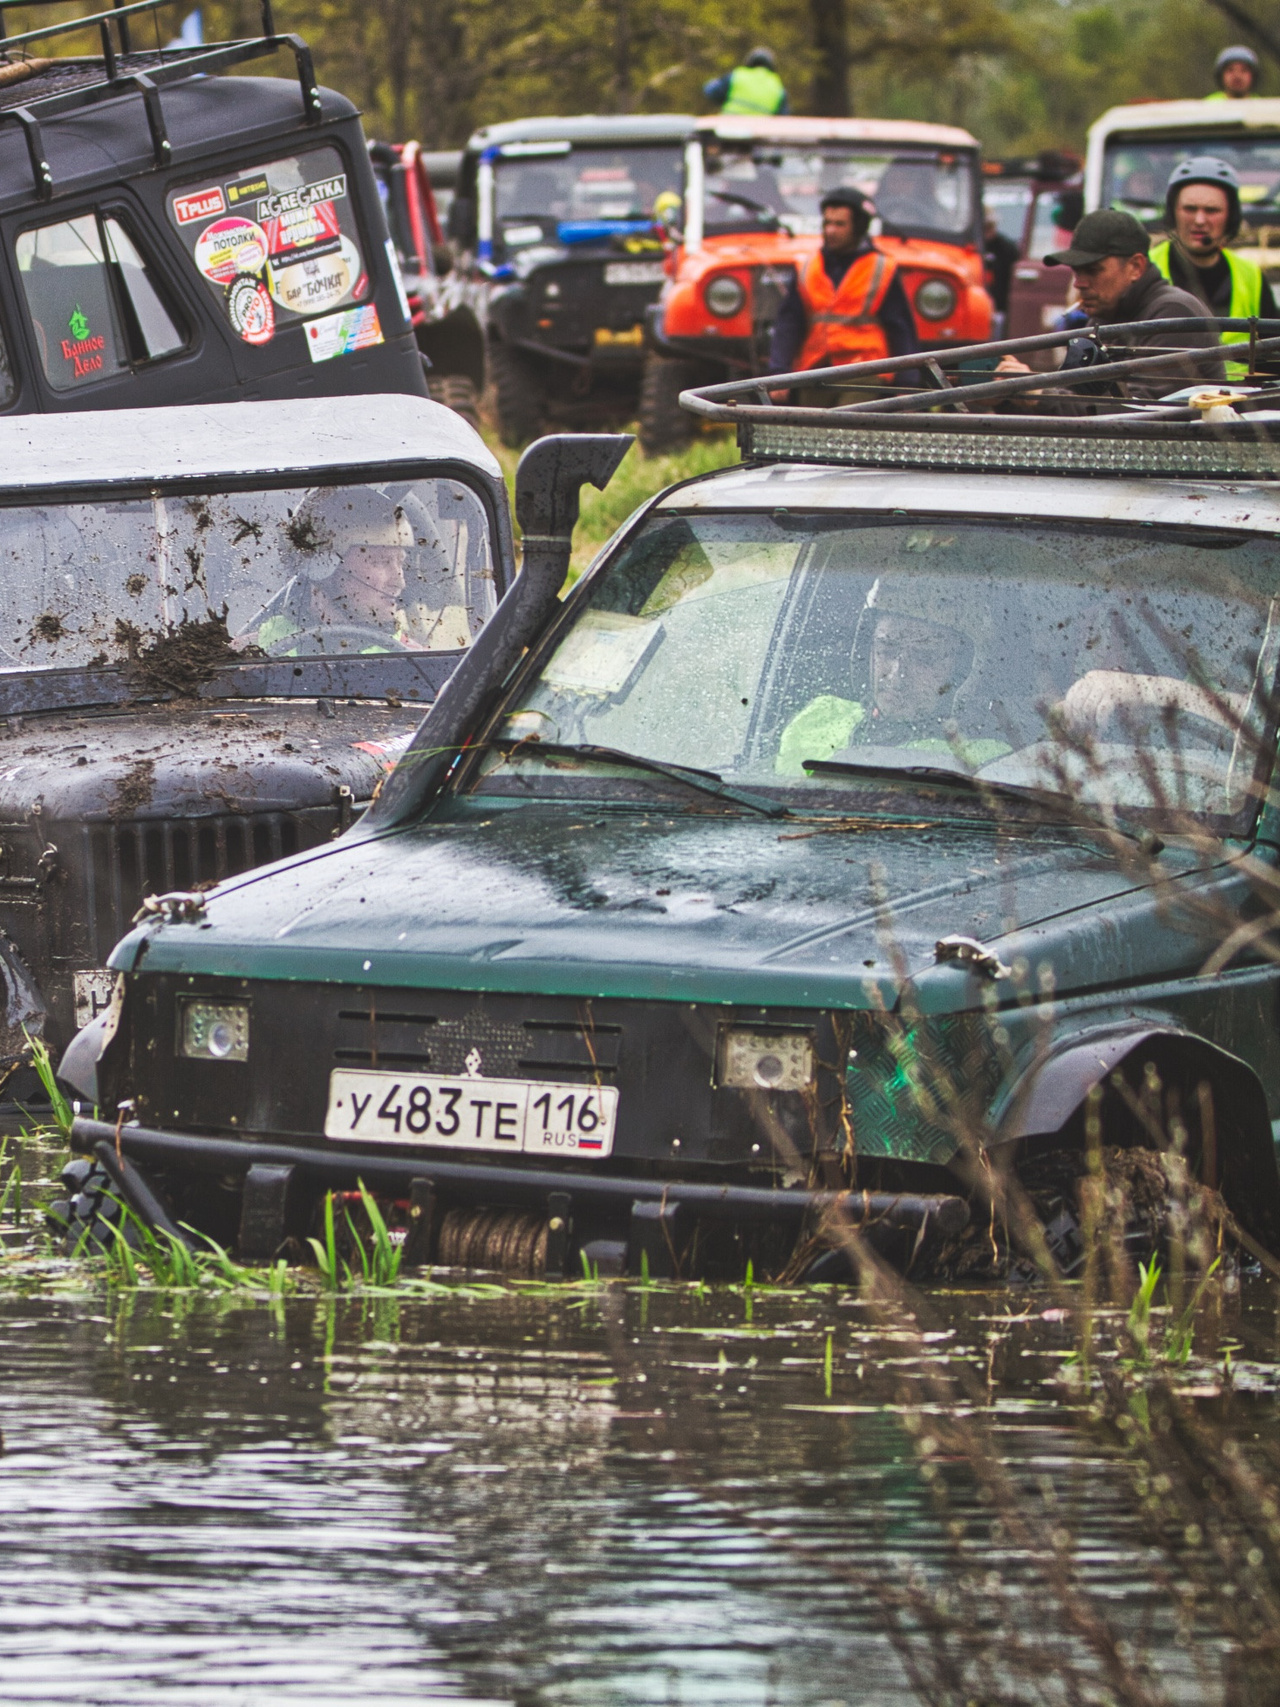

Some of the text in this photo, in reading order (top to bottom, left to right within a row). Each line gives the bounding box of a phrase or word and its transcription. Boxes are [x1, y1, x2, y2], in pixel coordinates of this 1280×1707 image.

[177, 196, 222, 219] TPLUS
[260, 180, 343, 217] AGREGATKA
[214, 231, 255, 250] ПОТОЛКИ
[286, 287, 301, 301] БАР
[242, 295, 252, 317] PRO
[61, 336, 104, 360] Банное
[75, 354, 102, 378] Дело
[350, 1084, 598, 1141] У483ТЕ 116
[543, 1132, 576, 1147] RUS
